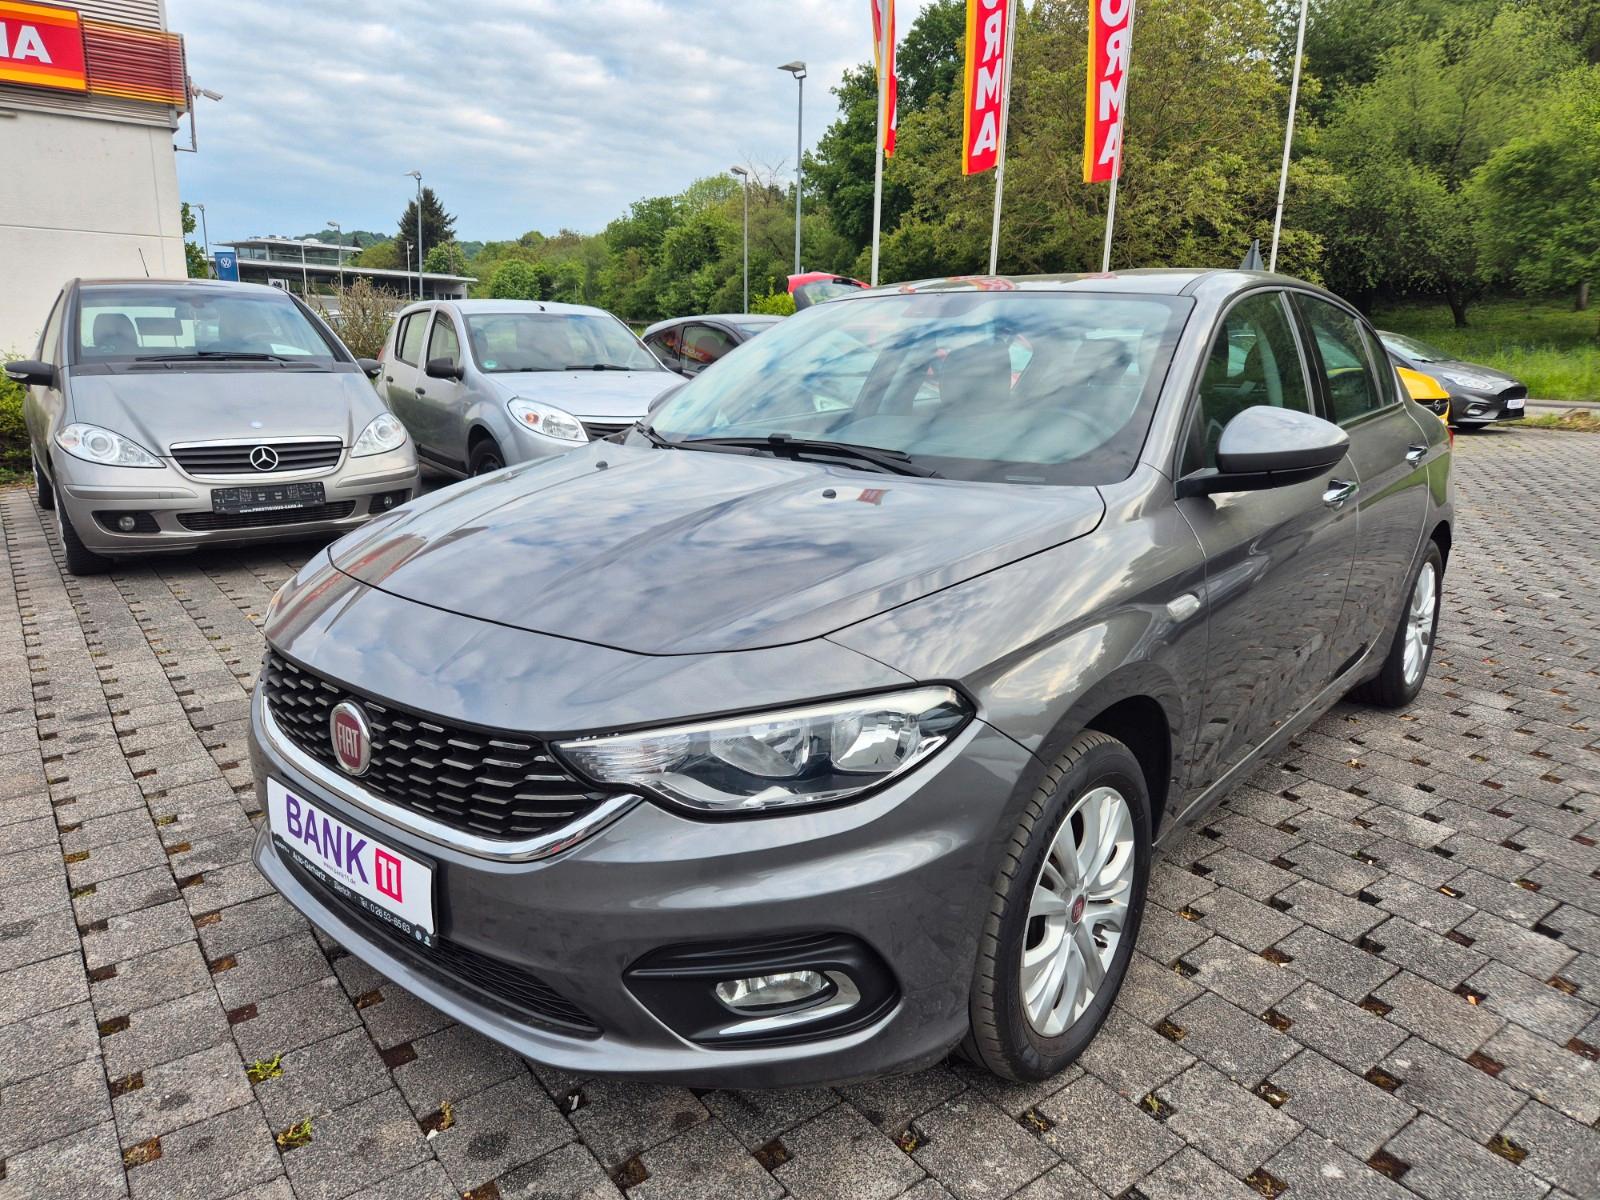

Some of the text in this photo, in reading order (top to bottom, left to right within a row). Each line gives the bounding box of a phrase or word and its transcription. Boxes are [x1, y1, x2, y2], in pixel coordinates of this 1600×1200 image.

[337, 721, 359, 759] FIAT
[286, 793, 399, 896] BANK 11
